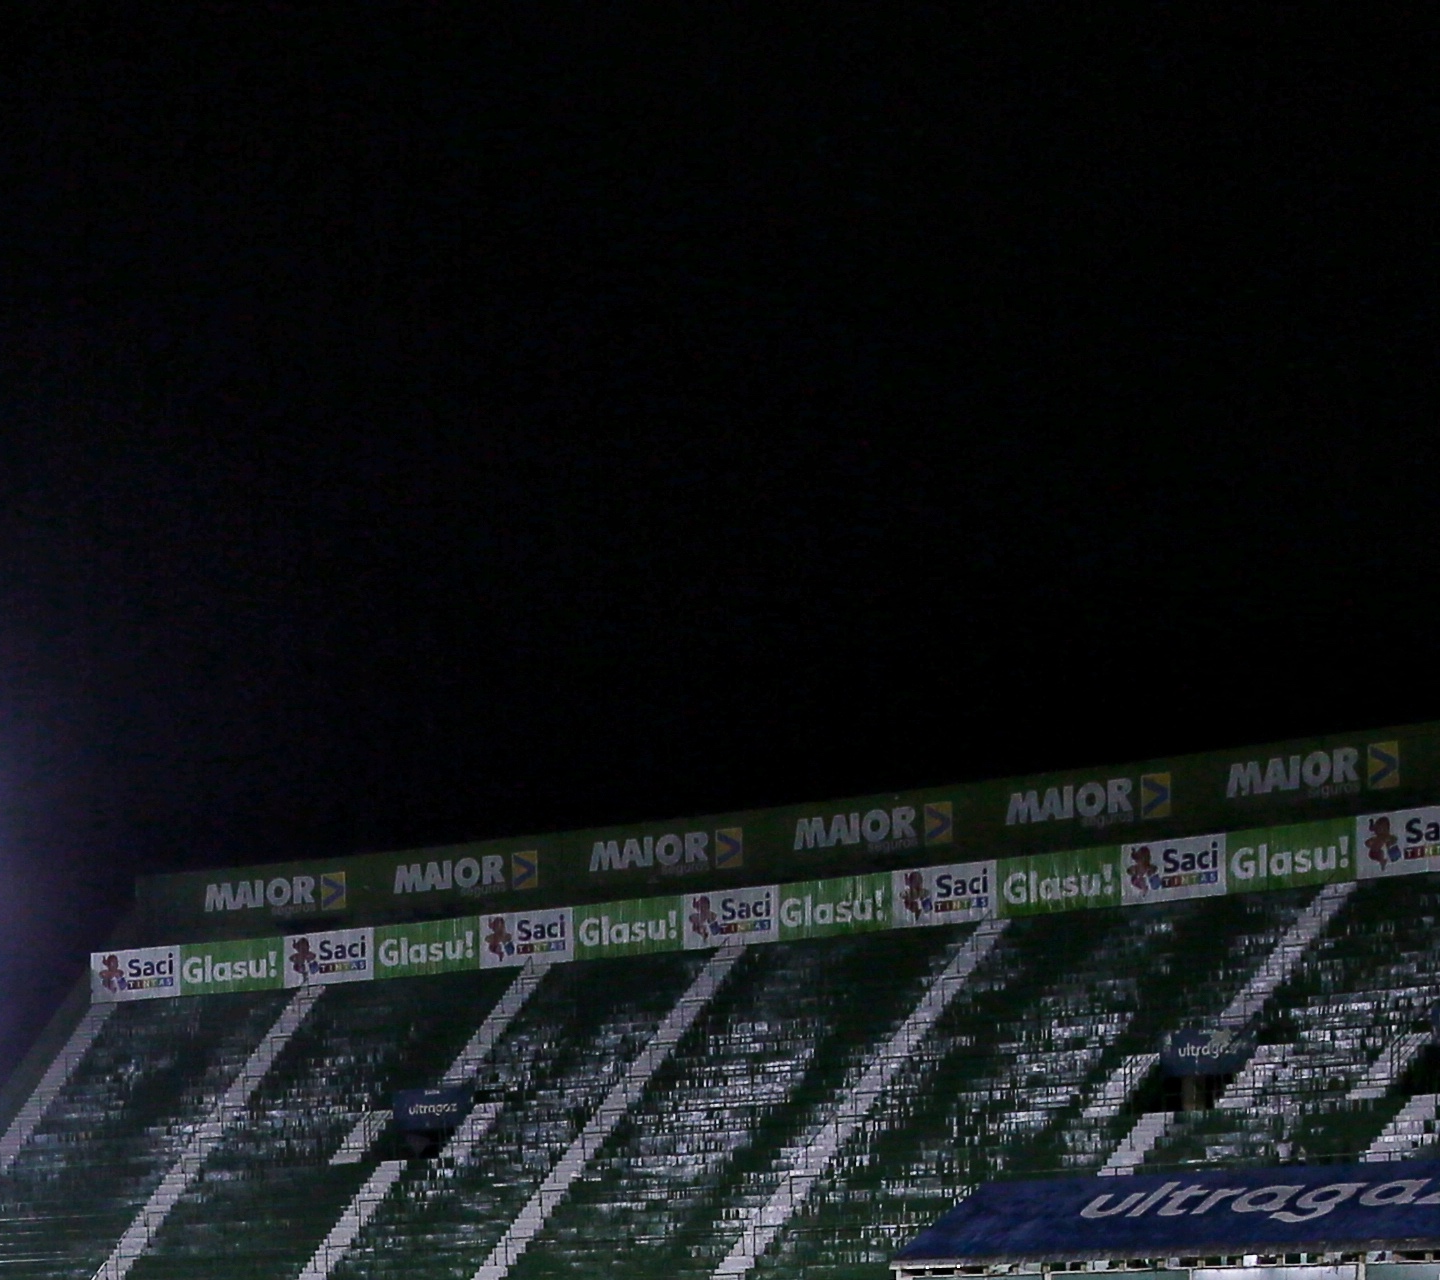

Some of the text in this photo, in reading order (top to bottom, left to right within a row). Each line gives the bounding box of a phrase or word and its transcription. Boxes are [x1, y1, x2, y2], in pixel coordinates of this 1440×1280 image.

[1226, 747, 1359, 798] MAIOR
[1005, 778, 1132, 825] MAIOR
[793, 807, 916, 851] MAIOR
[589, 832, 709, 872] MAIOR
[1163, 843, 1218, 873] Saci
[1231, 836, 1349, 879] Glasu!
[393, 855, 505, 894] MAIOR
[936, 869, 988, 898] Saci
[1003, 864, 1112, 905] Glasu!
[204, 876, 315, 912] MAIOR
[721, 892, 771, 920] Saci
[780, 890, 883, 928] Glasu!
[517, 915, 565, 941] Saci
[578, 910, 677, 947] Glasu!
[128, 953, 174, 977] Saci
[320, 935, 366, 960] Saci
[379, 930, 474, 968] Glasu!
[182, 951, 278, 984] Glasu!
